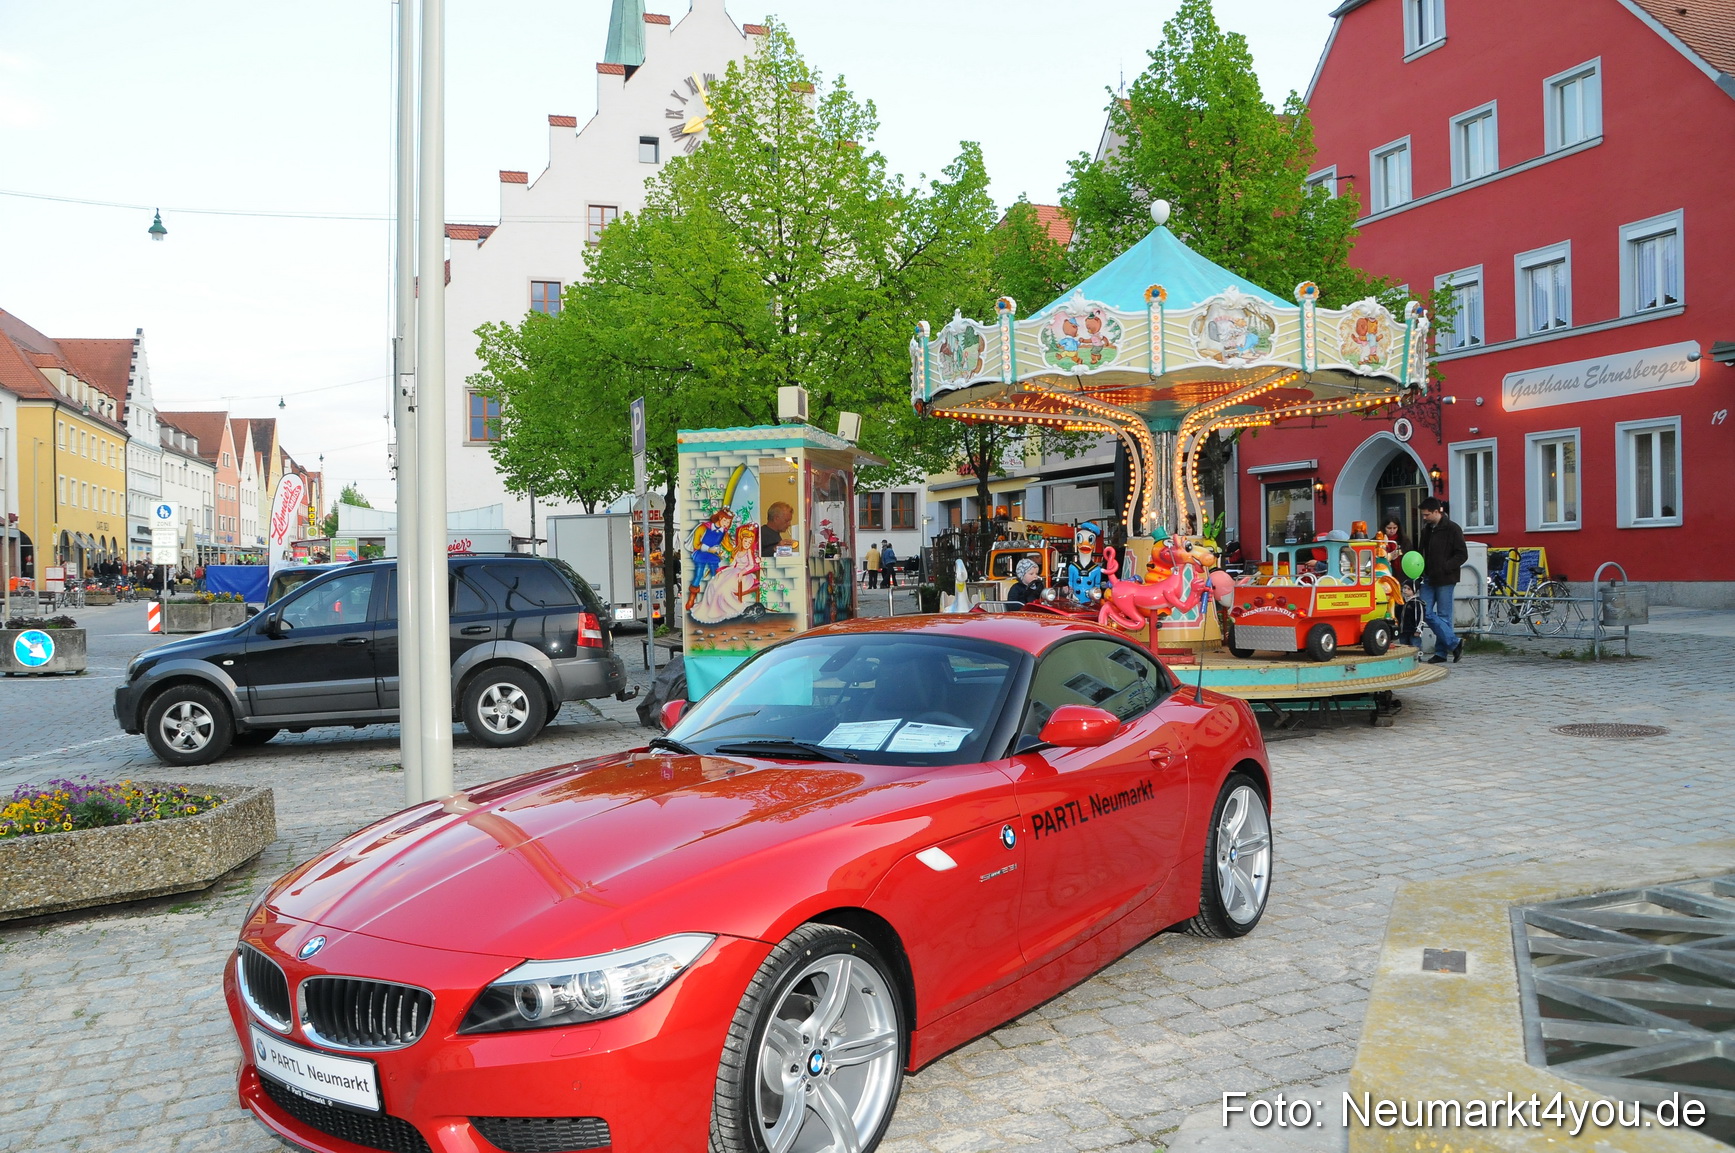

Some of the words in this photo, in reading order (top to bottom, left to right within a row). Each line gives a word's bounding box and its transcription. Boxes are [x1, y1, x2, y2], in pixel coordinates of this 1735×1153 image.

[1510, 374, 1580, 406] Gasthaus
[1583, 358, 1688, 389] Ehrnsberger
[633, 406, 642, 446] P
[1711, 409, 1728, 425] 19
[633, 510, 664, 520] MADEL
[1241, 605, 1296, 619] DISNEYLANDIA
[1031, 800, 1088, 841] PARTL
[1088, 779, 1155, 819] Neumarkt
[270, 1049, 305, 1076] PARTL
[307, 1064, 370, 1092] Neumarkt
